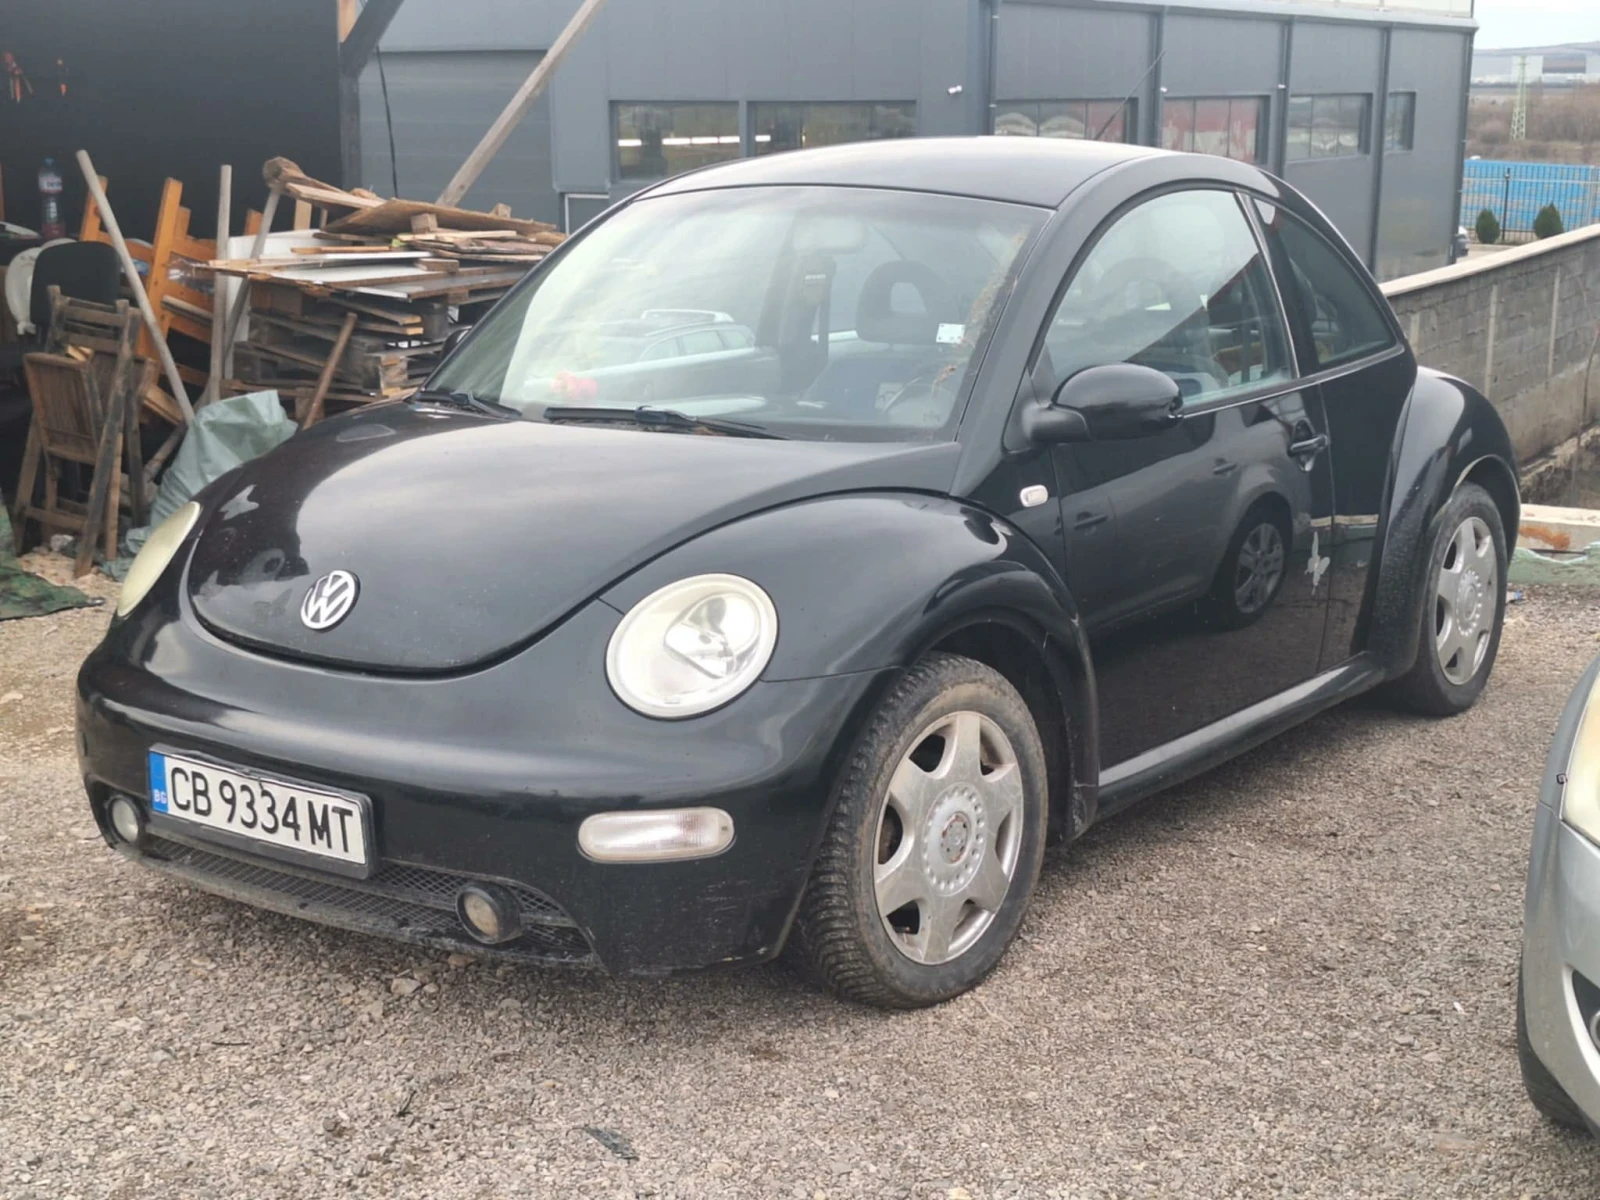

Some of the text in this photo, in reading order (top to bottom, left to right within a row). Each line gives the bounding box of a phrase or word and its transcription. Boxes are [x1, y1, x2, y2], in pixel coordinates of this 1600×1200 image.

[301, 570, 355, 629] VW
[153, 788, 167, 804] BG
[171, 767, 353, 853] CB 9334 MT
